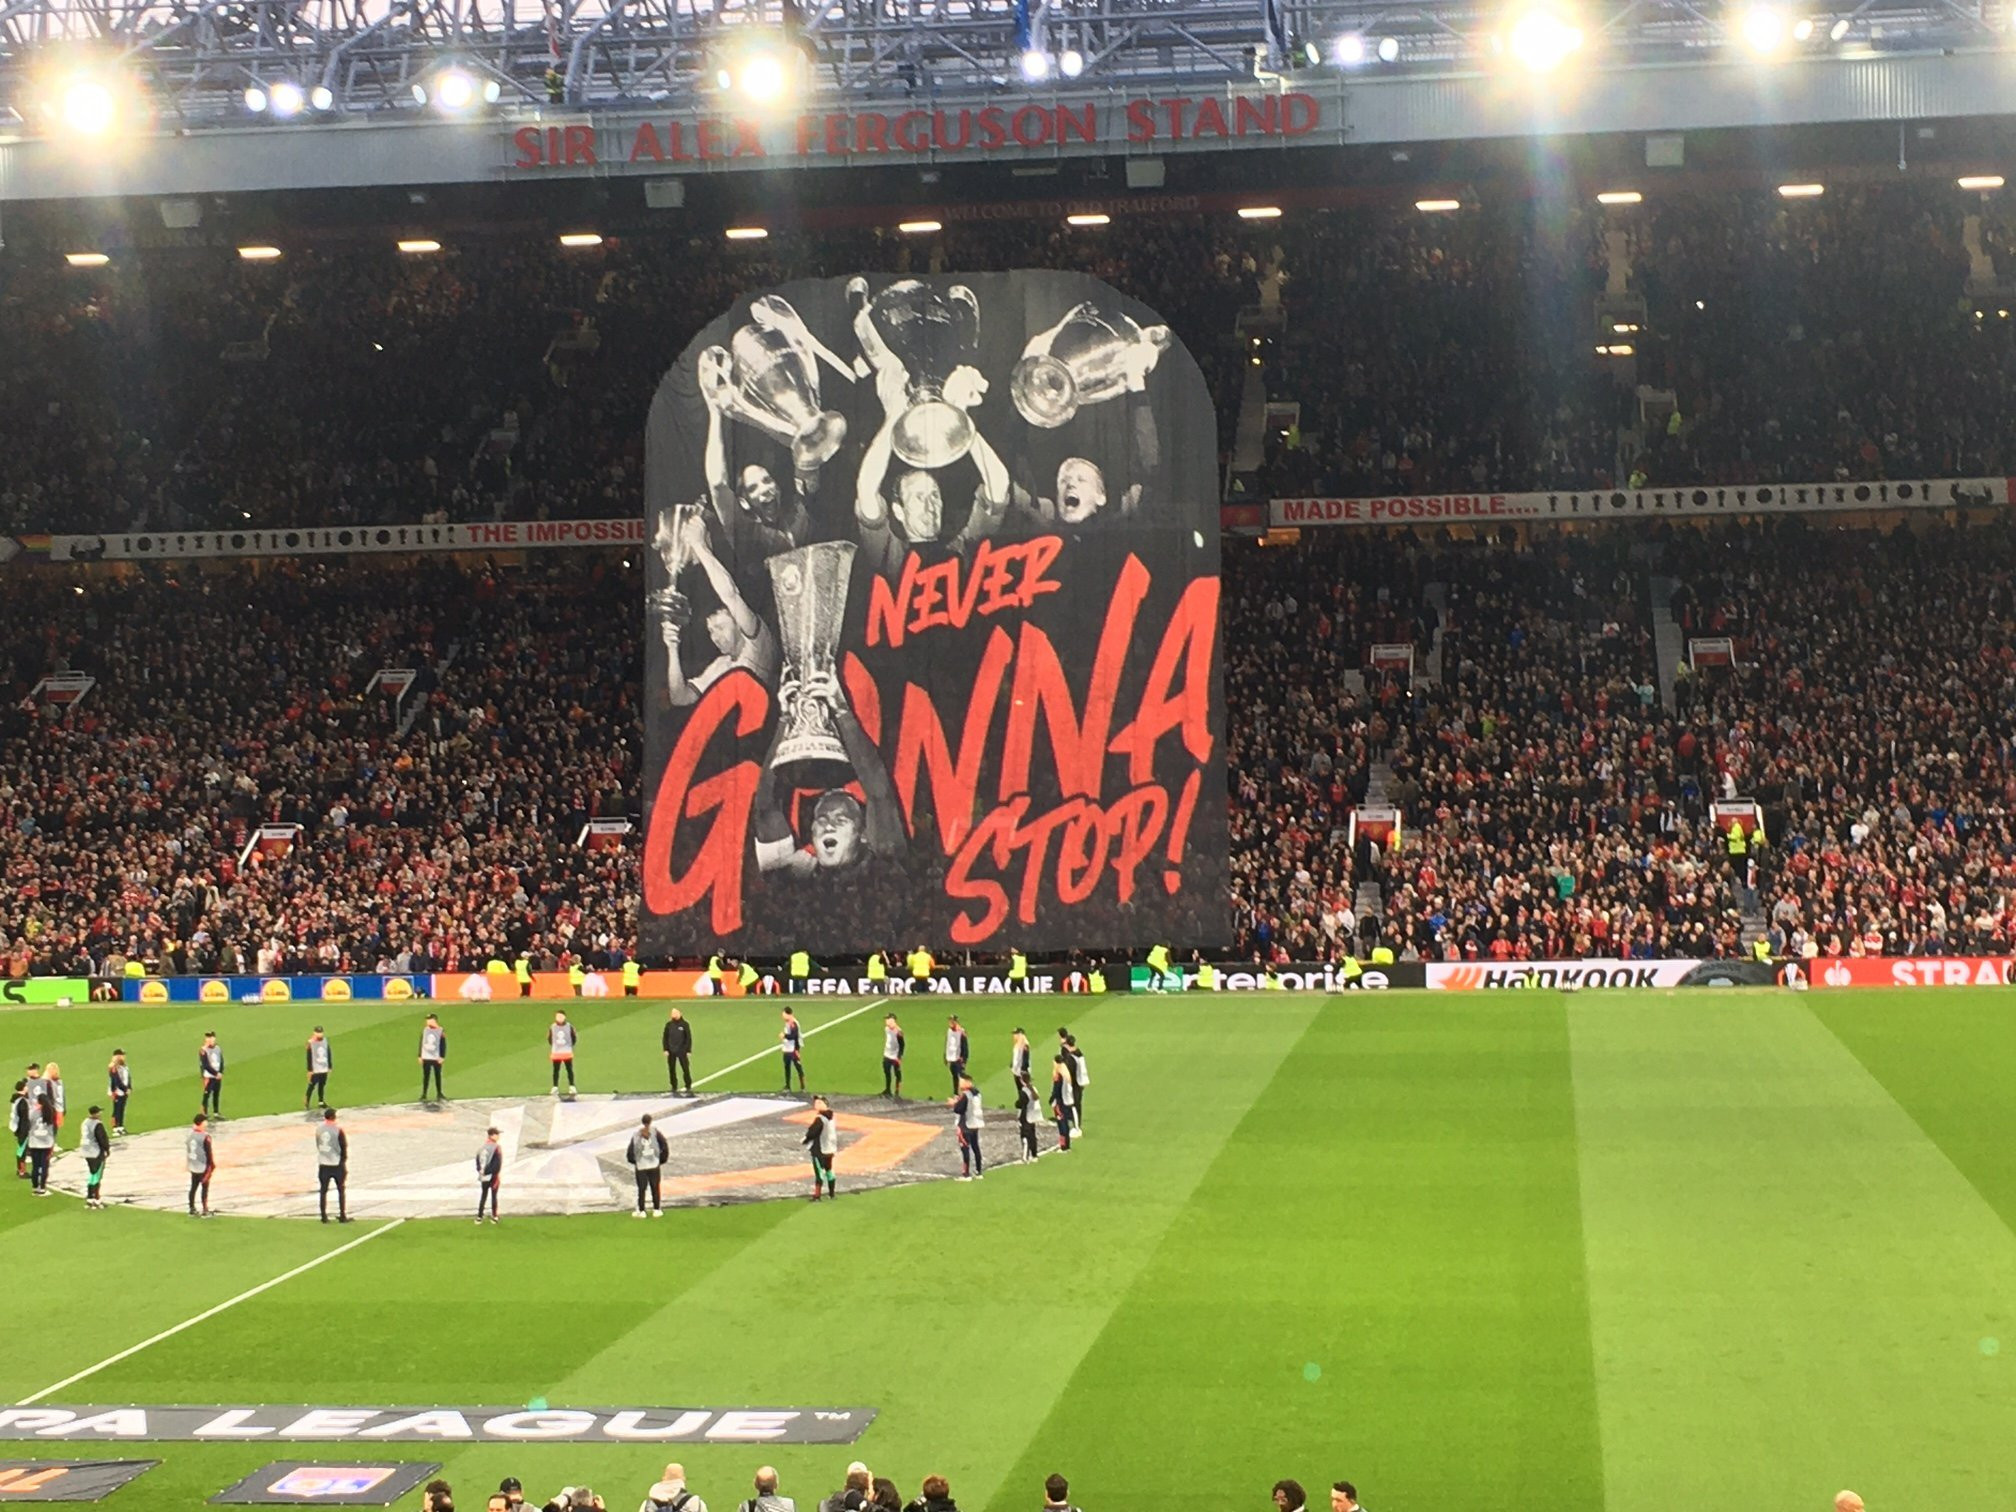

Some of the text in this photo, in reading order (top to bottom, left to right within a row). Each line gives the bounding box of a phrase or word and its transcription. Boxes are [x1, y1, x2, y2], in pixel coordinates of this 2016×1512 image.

[514, 92, 1321, 169] SIR ALEX FERGUSON STAND
[466, 523, 518, 543] THE
[1283, 500, 1361, 521] MADE
[866, 535, 1063, 648] NEVER
[945, 768, 1201, 944] STOP!
[193, 1408, 801, 1439] LEAGUE
